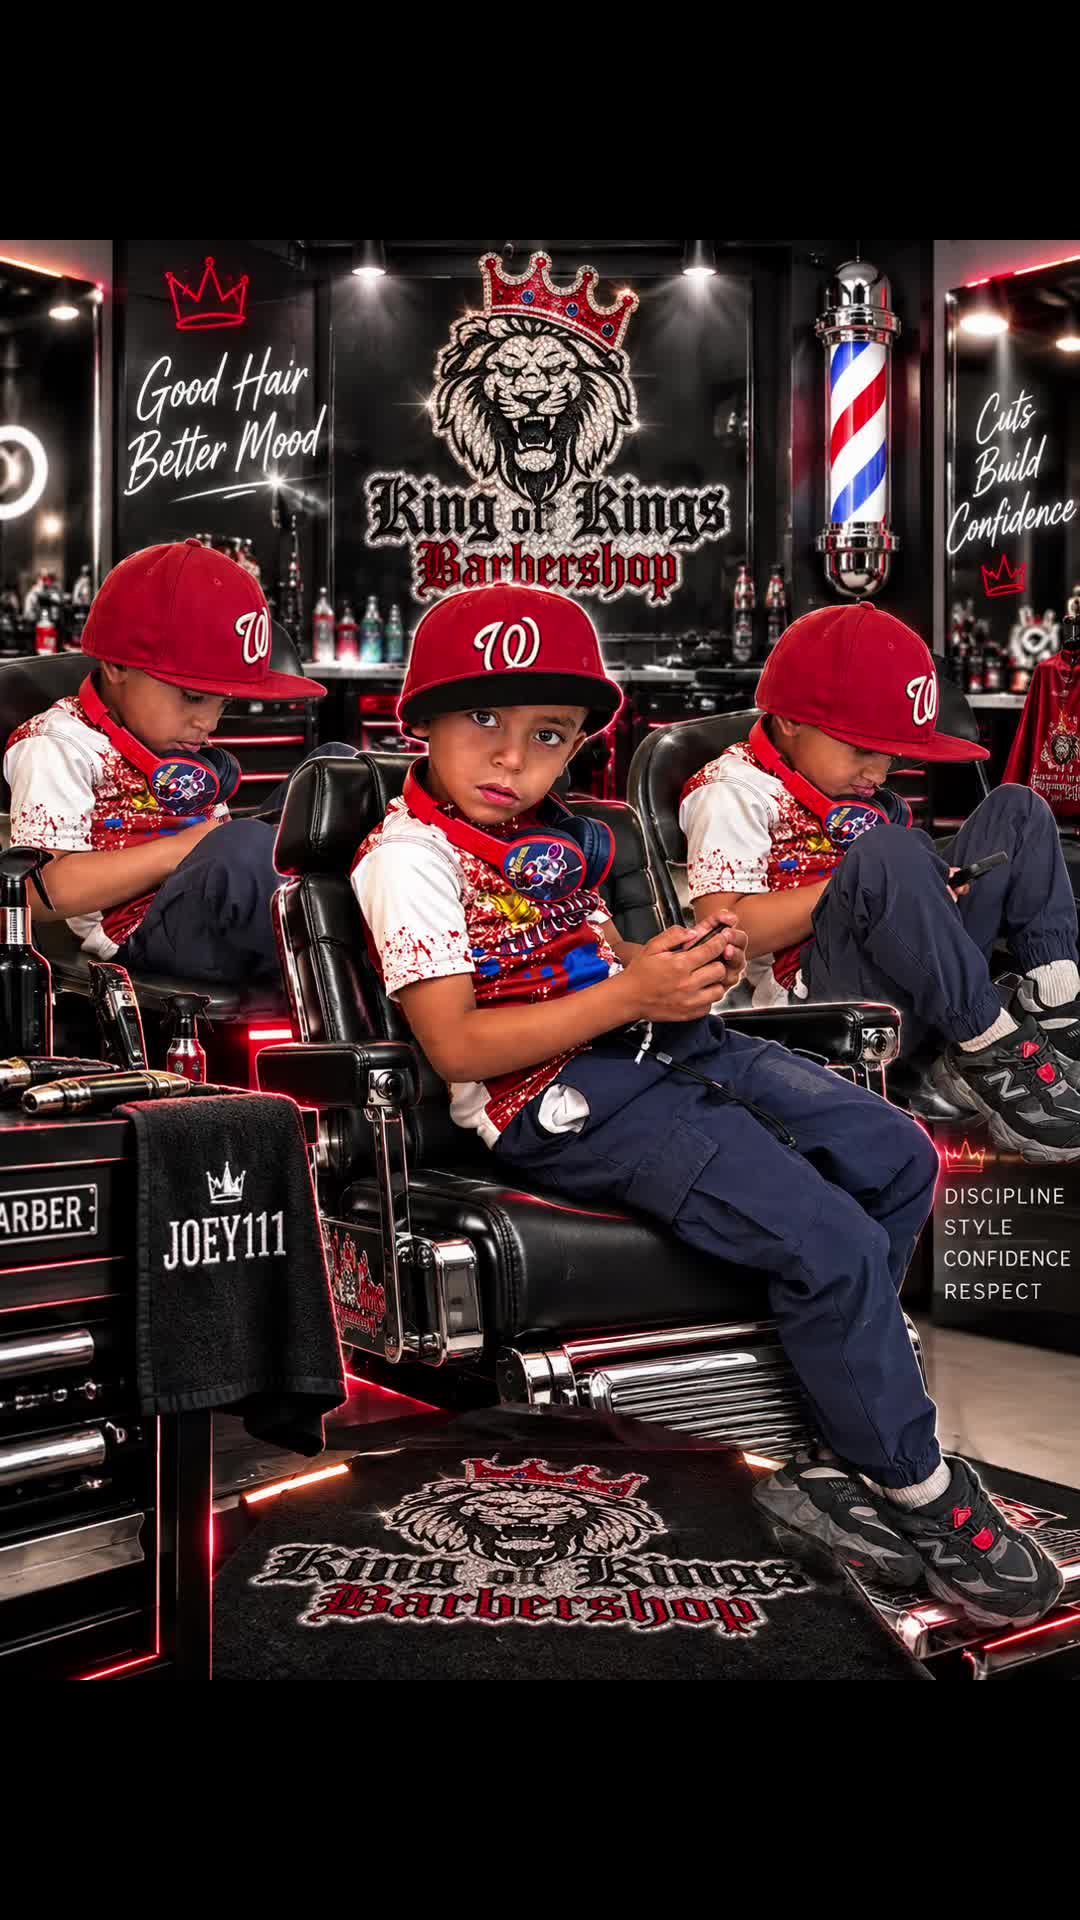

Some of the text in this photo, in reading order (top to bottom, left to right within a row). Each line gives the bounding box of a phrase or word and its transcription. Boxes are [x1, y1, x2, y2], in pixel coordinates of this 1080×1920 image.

[136, 346, 308, 425] Good Hair
[976, 389, 1036, 445] Cuts
[123, 404, 327, 496] Better Mood
[972, 434, 1047, 498] Build
[368, 475, 727, 545] King of Kings
[946, 490, 1077, 555] Confidence
[415, 540, 677, 600] Barbershop
[945, 1187, 1065, 1205] DISCIPLINE
[163, 1210, 287, 1271] JOEY111
[944, 1218, 1013, 1236] STYLE
[943, 1250, 1072, 1267] CONFIDENCE
[944, 1283, 1043, 1300] RESPECT
[255, 1545, 465, 1591] King
[570, 1553, 810, 1597] Kings
[305, 1582, 757, 1635] Barbershop
